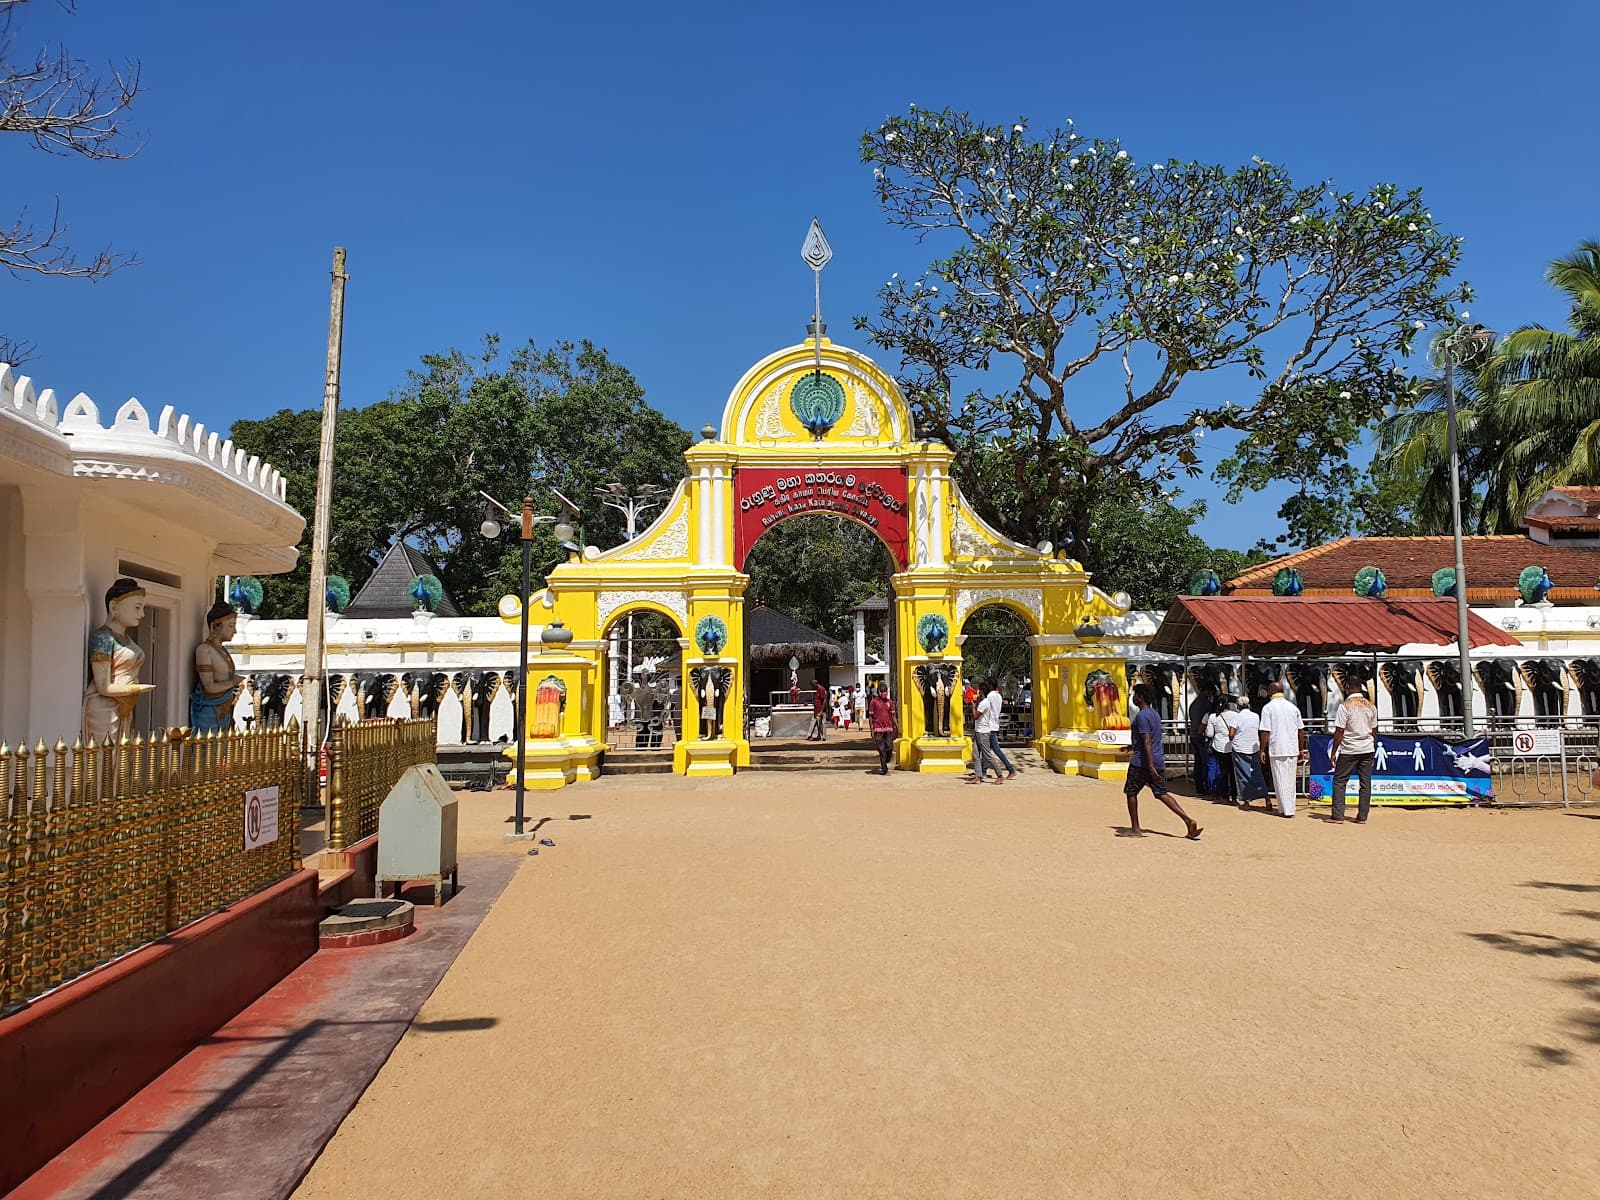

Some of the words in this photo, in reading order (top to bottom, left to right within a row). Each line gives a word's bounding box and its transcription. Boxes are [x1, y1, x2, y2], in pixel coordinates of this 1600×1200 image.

[740, 485, 776, 510] රුහුණු
[776, 475, 801, 490] මහා
[805, 472, 856, 487] කතරගම
